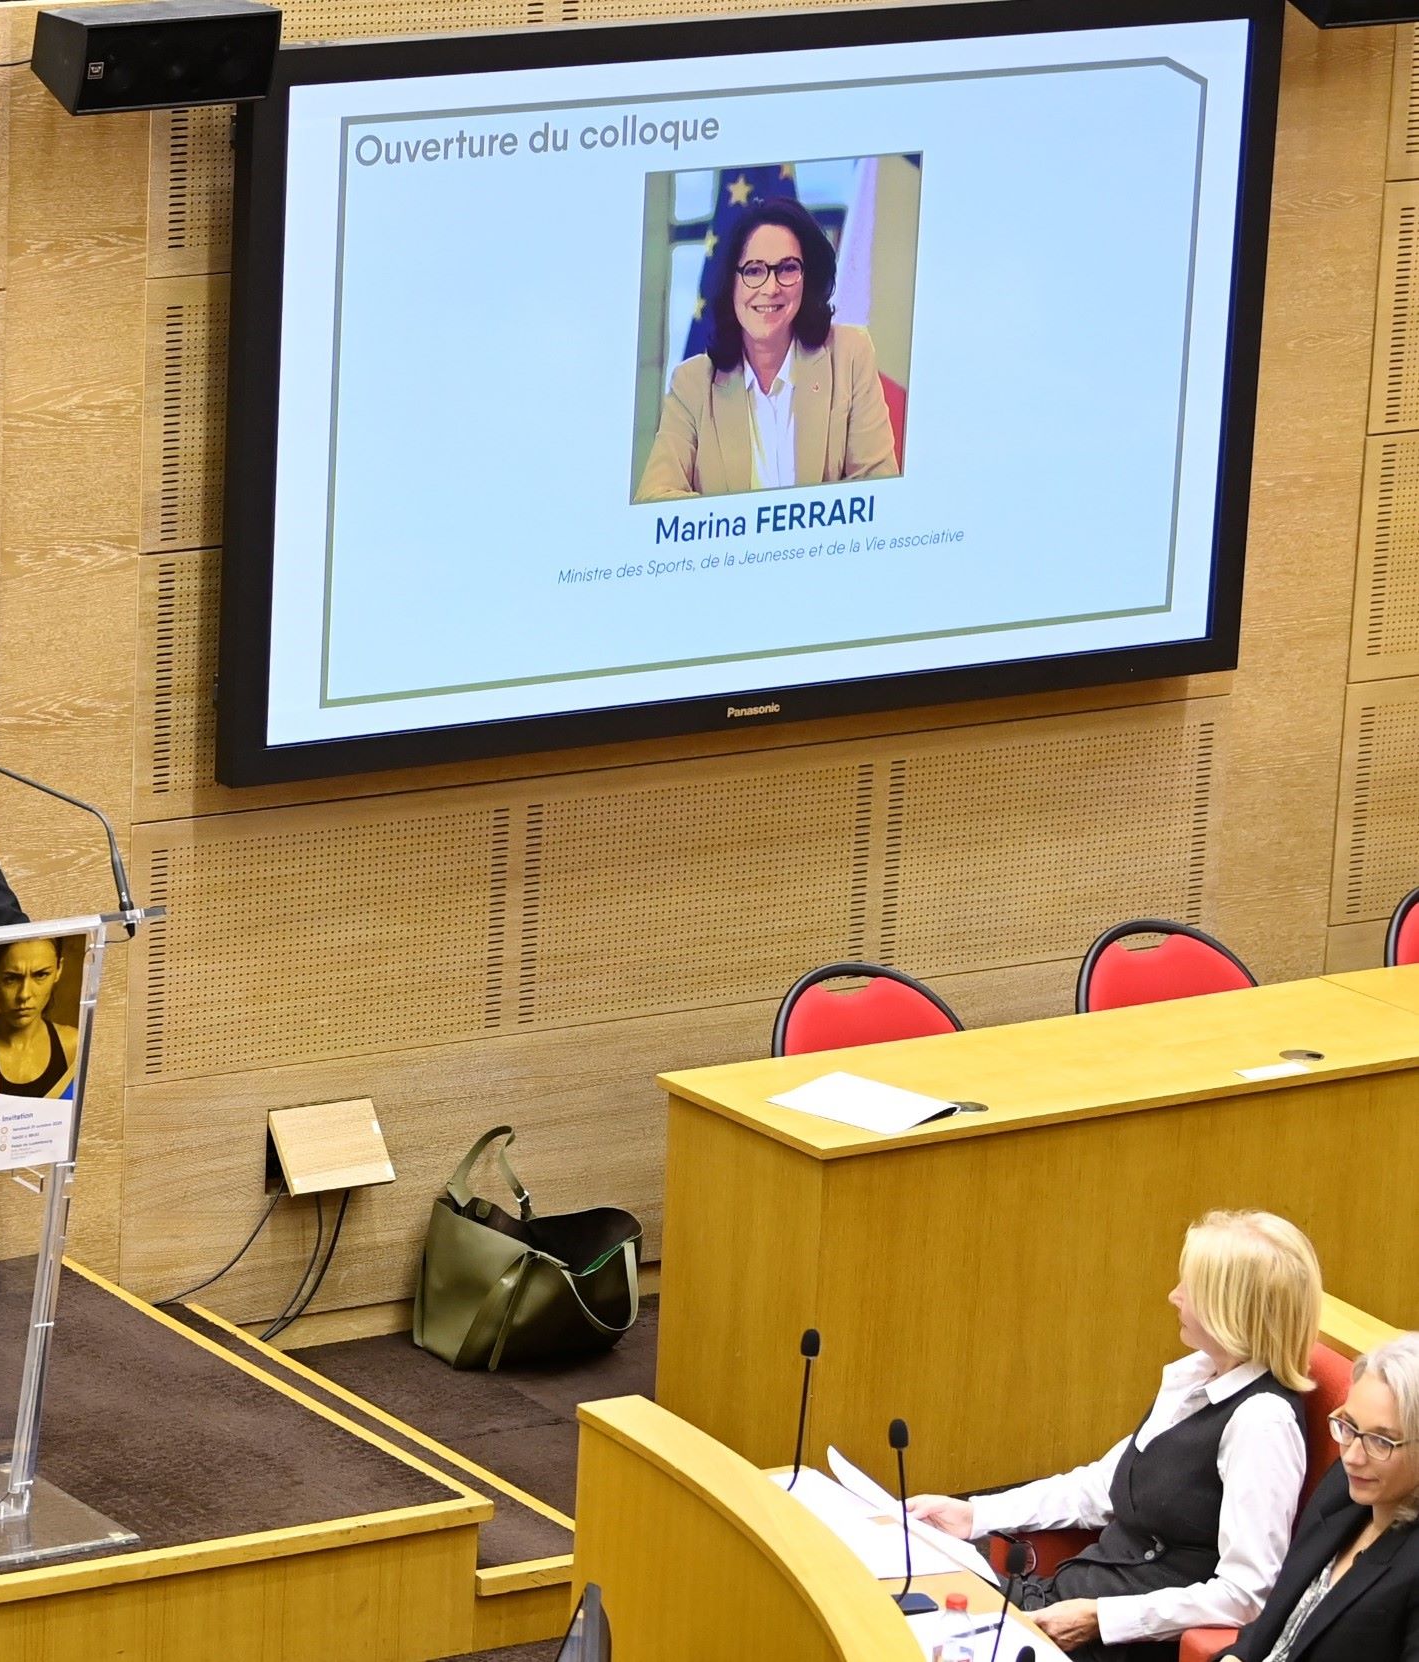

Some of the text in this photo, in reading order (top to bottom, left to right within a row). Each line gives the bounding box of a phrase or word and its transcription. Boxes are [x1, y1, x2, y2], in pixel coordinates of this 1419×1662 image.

[355, 114, 720, 167] Ouverture du colloque
[655, 495, 875, 544] Marina FERRARI
[557, 528, 965, 585] Ministre des Sports, de la Jeunesse et de la Vie associative
[727, 702, 780, 718] Panasonic
